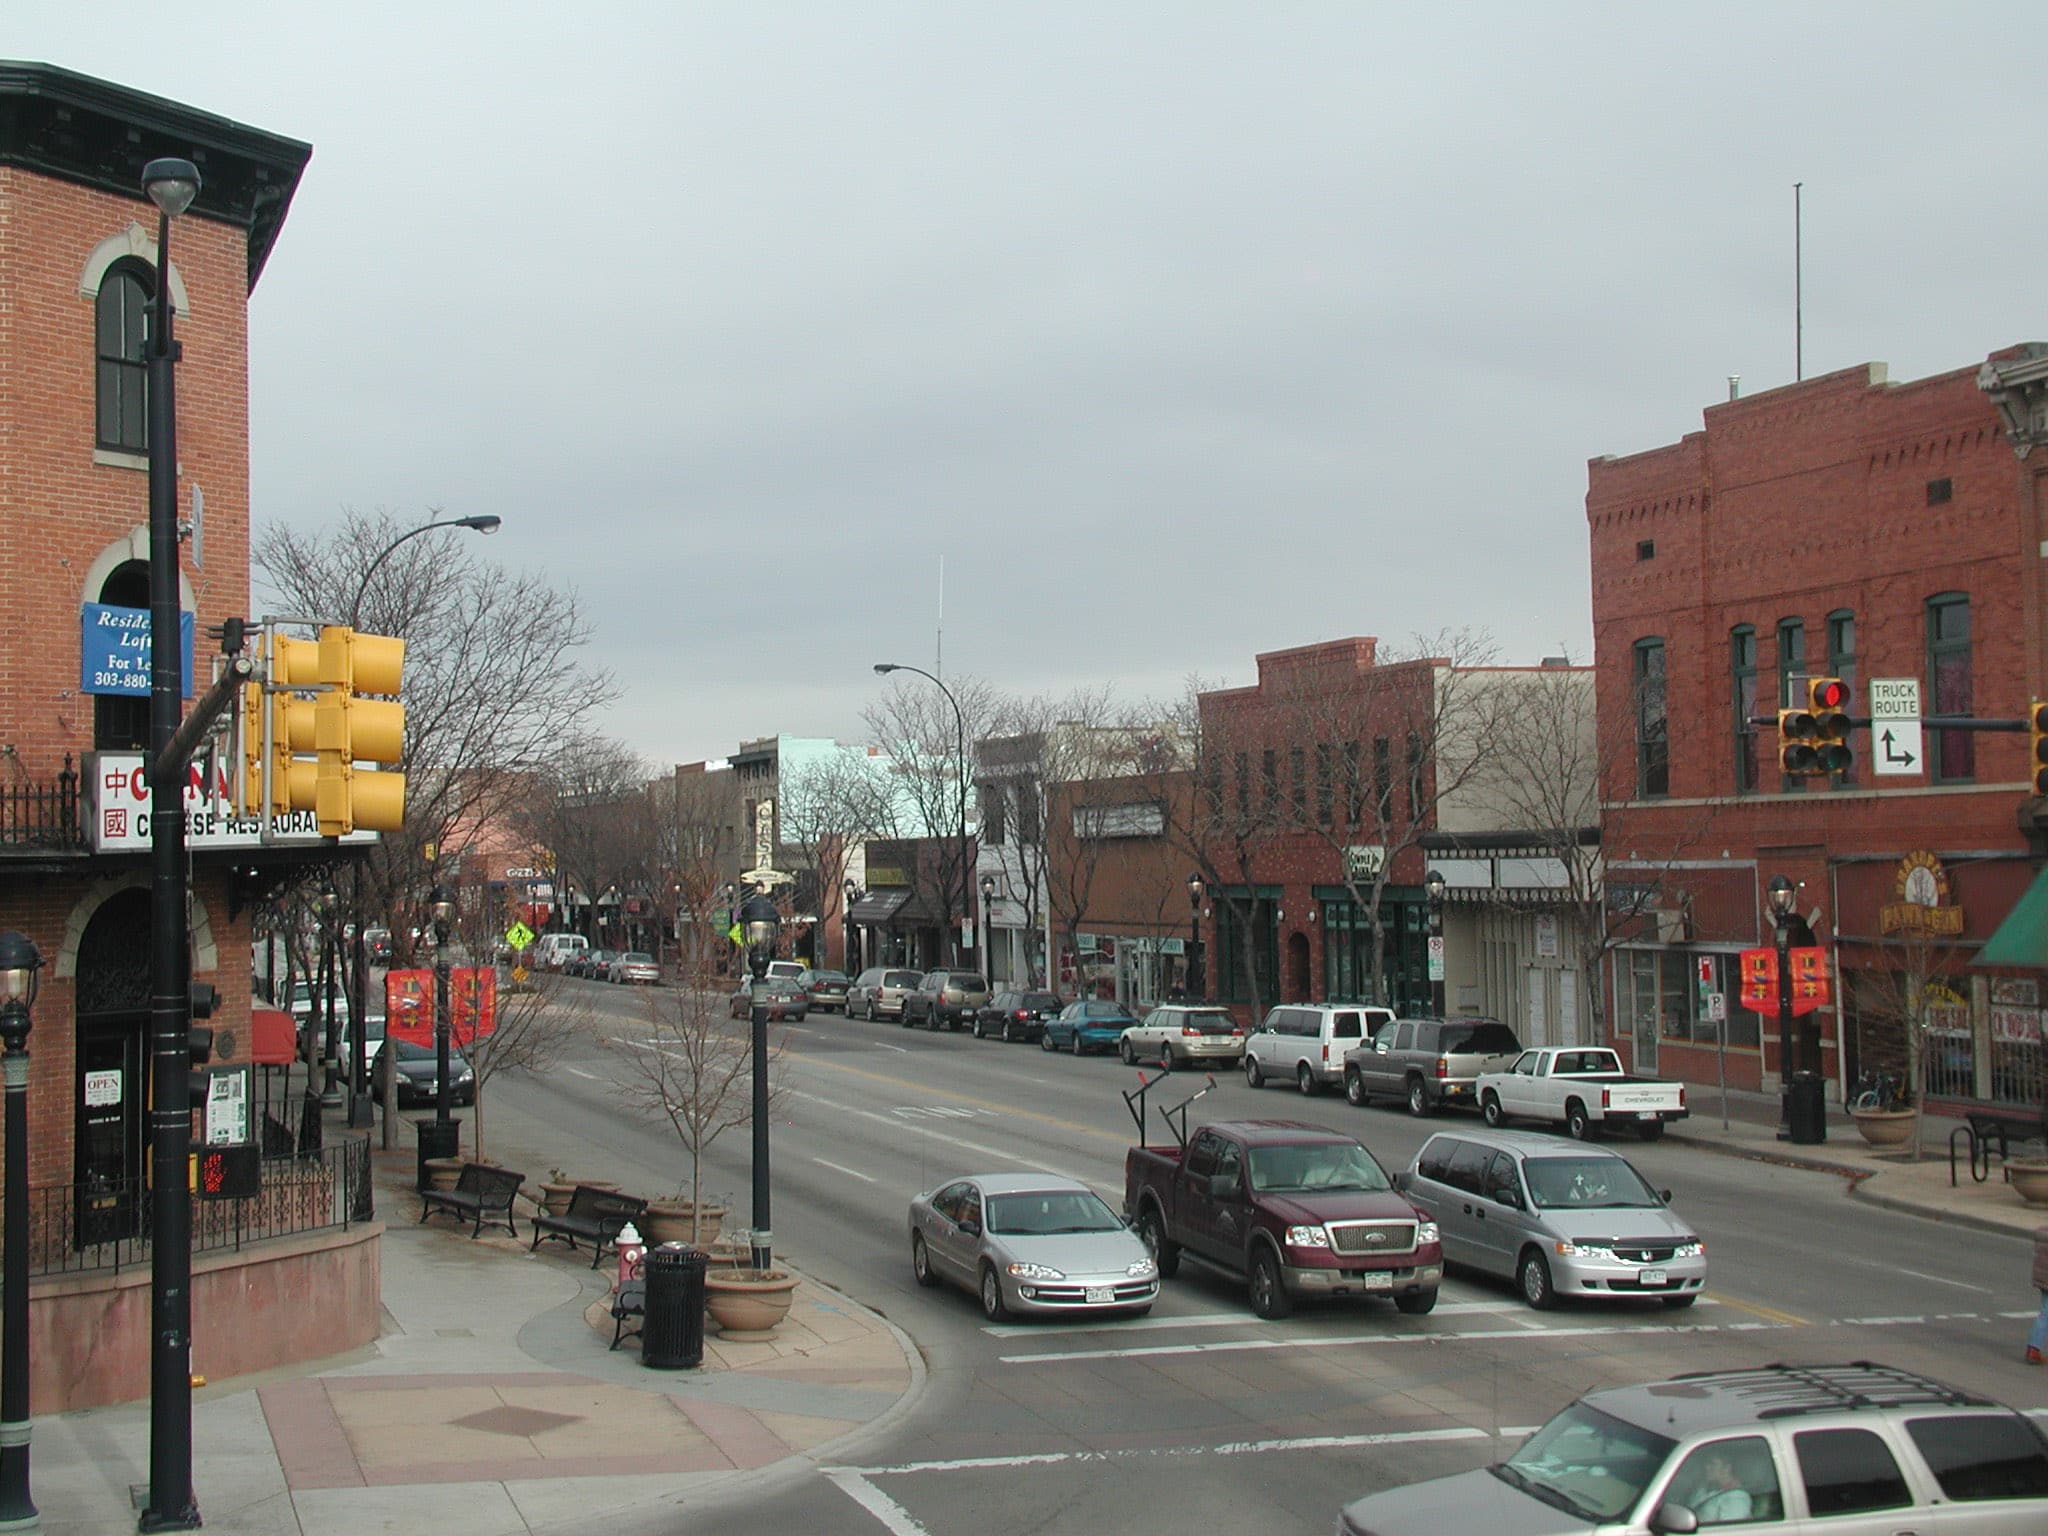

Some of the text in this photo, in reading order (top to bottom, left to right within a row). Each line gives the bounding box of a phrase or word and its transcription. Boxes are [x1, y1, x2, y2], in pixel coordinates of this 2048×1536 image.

[108, 654, 130, 669] For
[1875, 684, 1916, 698] TRUCK
[1875, 700, 1917, 714] ROUTE
[759, 806, 770, 868] CASA
[87, 1079, 119, 1090] OPEN
[1624, 1096, 1665, 1104] CHEVROLET
